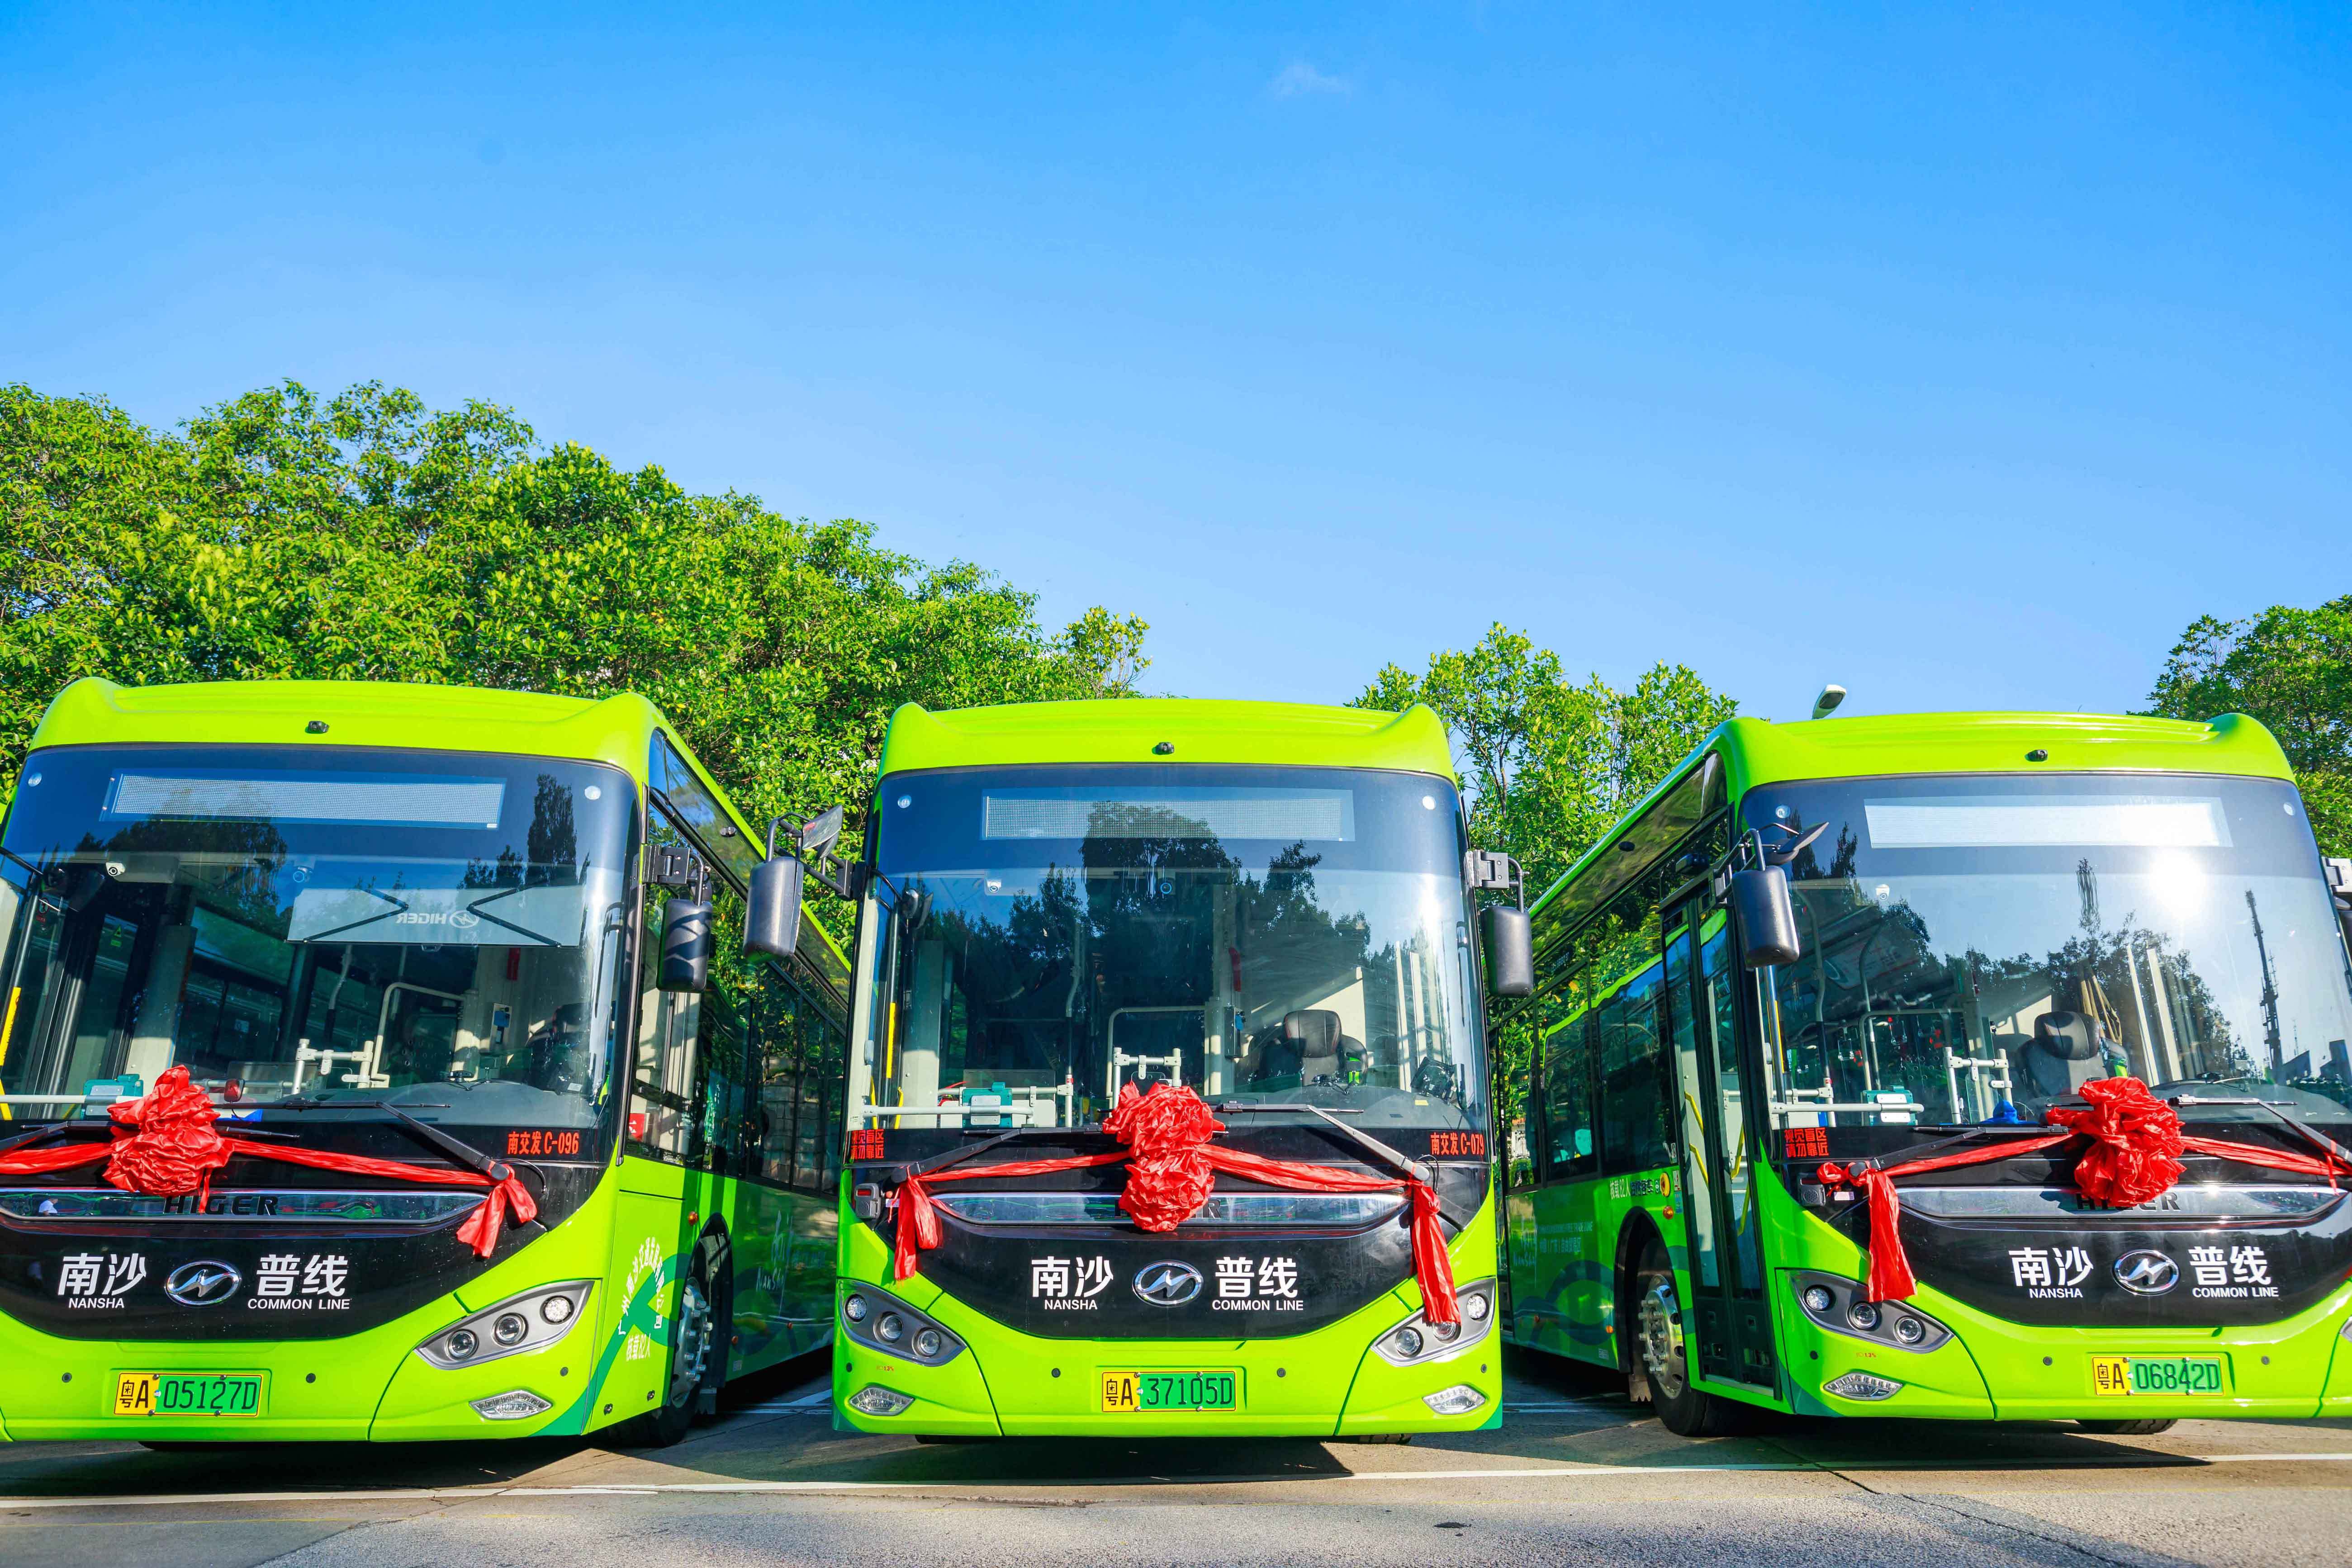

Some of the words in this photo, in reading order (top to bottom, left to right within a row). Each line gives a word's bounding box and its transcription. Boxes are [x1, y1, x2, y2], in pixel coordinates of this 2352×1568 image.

[507, 1131, 542, 1155] 南交发
[544, 1131, 579, 1154] C-096
[1430, 1132, 1459, 1156] 南交发
[1461, 1132, 1484, 1156] C-079
[1784, 1127, 1826, 1143] 视觉盲区
[1786, 1142, 1829, 1158] 请勿靠近
[163, 1195, 278, 1216] HIGER
[58, 1253, 147, 1296] 南沙
[256, 1254, 348, 1297] 普线
[1031, 1256, 1114, 1298] 南沙
[1215, 1256, 1298, 1298] 普线
[2008, 1246, 2094, 1287] 南沙
[2188, 1246, 2271, 1285] 普线
[68, 1298, 124, 1308] NANSHA
[247, 1298, 312, 1309] COMMON
[318, 1299, 350, 1310] LINE
[1044, 1299, 1098, 1310] NANSHA
[2030, 1288, 2083, 1298] NANSHA
[2192, 1287, 2248, 1298] COMMON
[2252, 1287, 2279, 1297] LINE
[1212, 1299, 1270, 1311] COMMON
[1276, 1300, 1304, 1311] LINE
[2097, 1363, 2125, 1389] 粤A
[2136, 1363, 2220, 1390] 06842D
[120, 1379, 149, 1409] 粤A
[163, 1380, 258, 1410] 05127D
[1105, 1378, 1133, 1406] 粤A
[1147, 1377, 1233, 1405] 37105D
